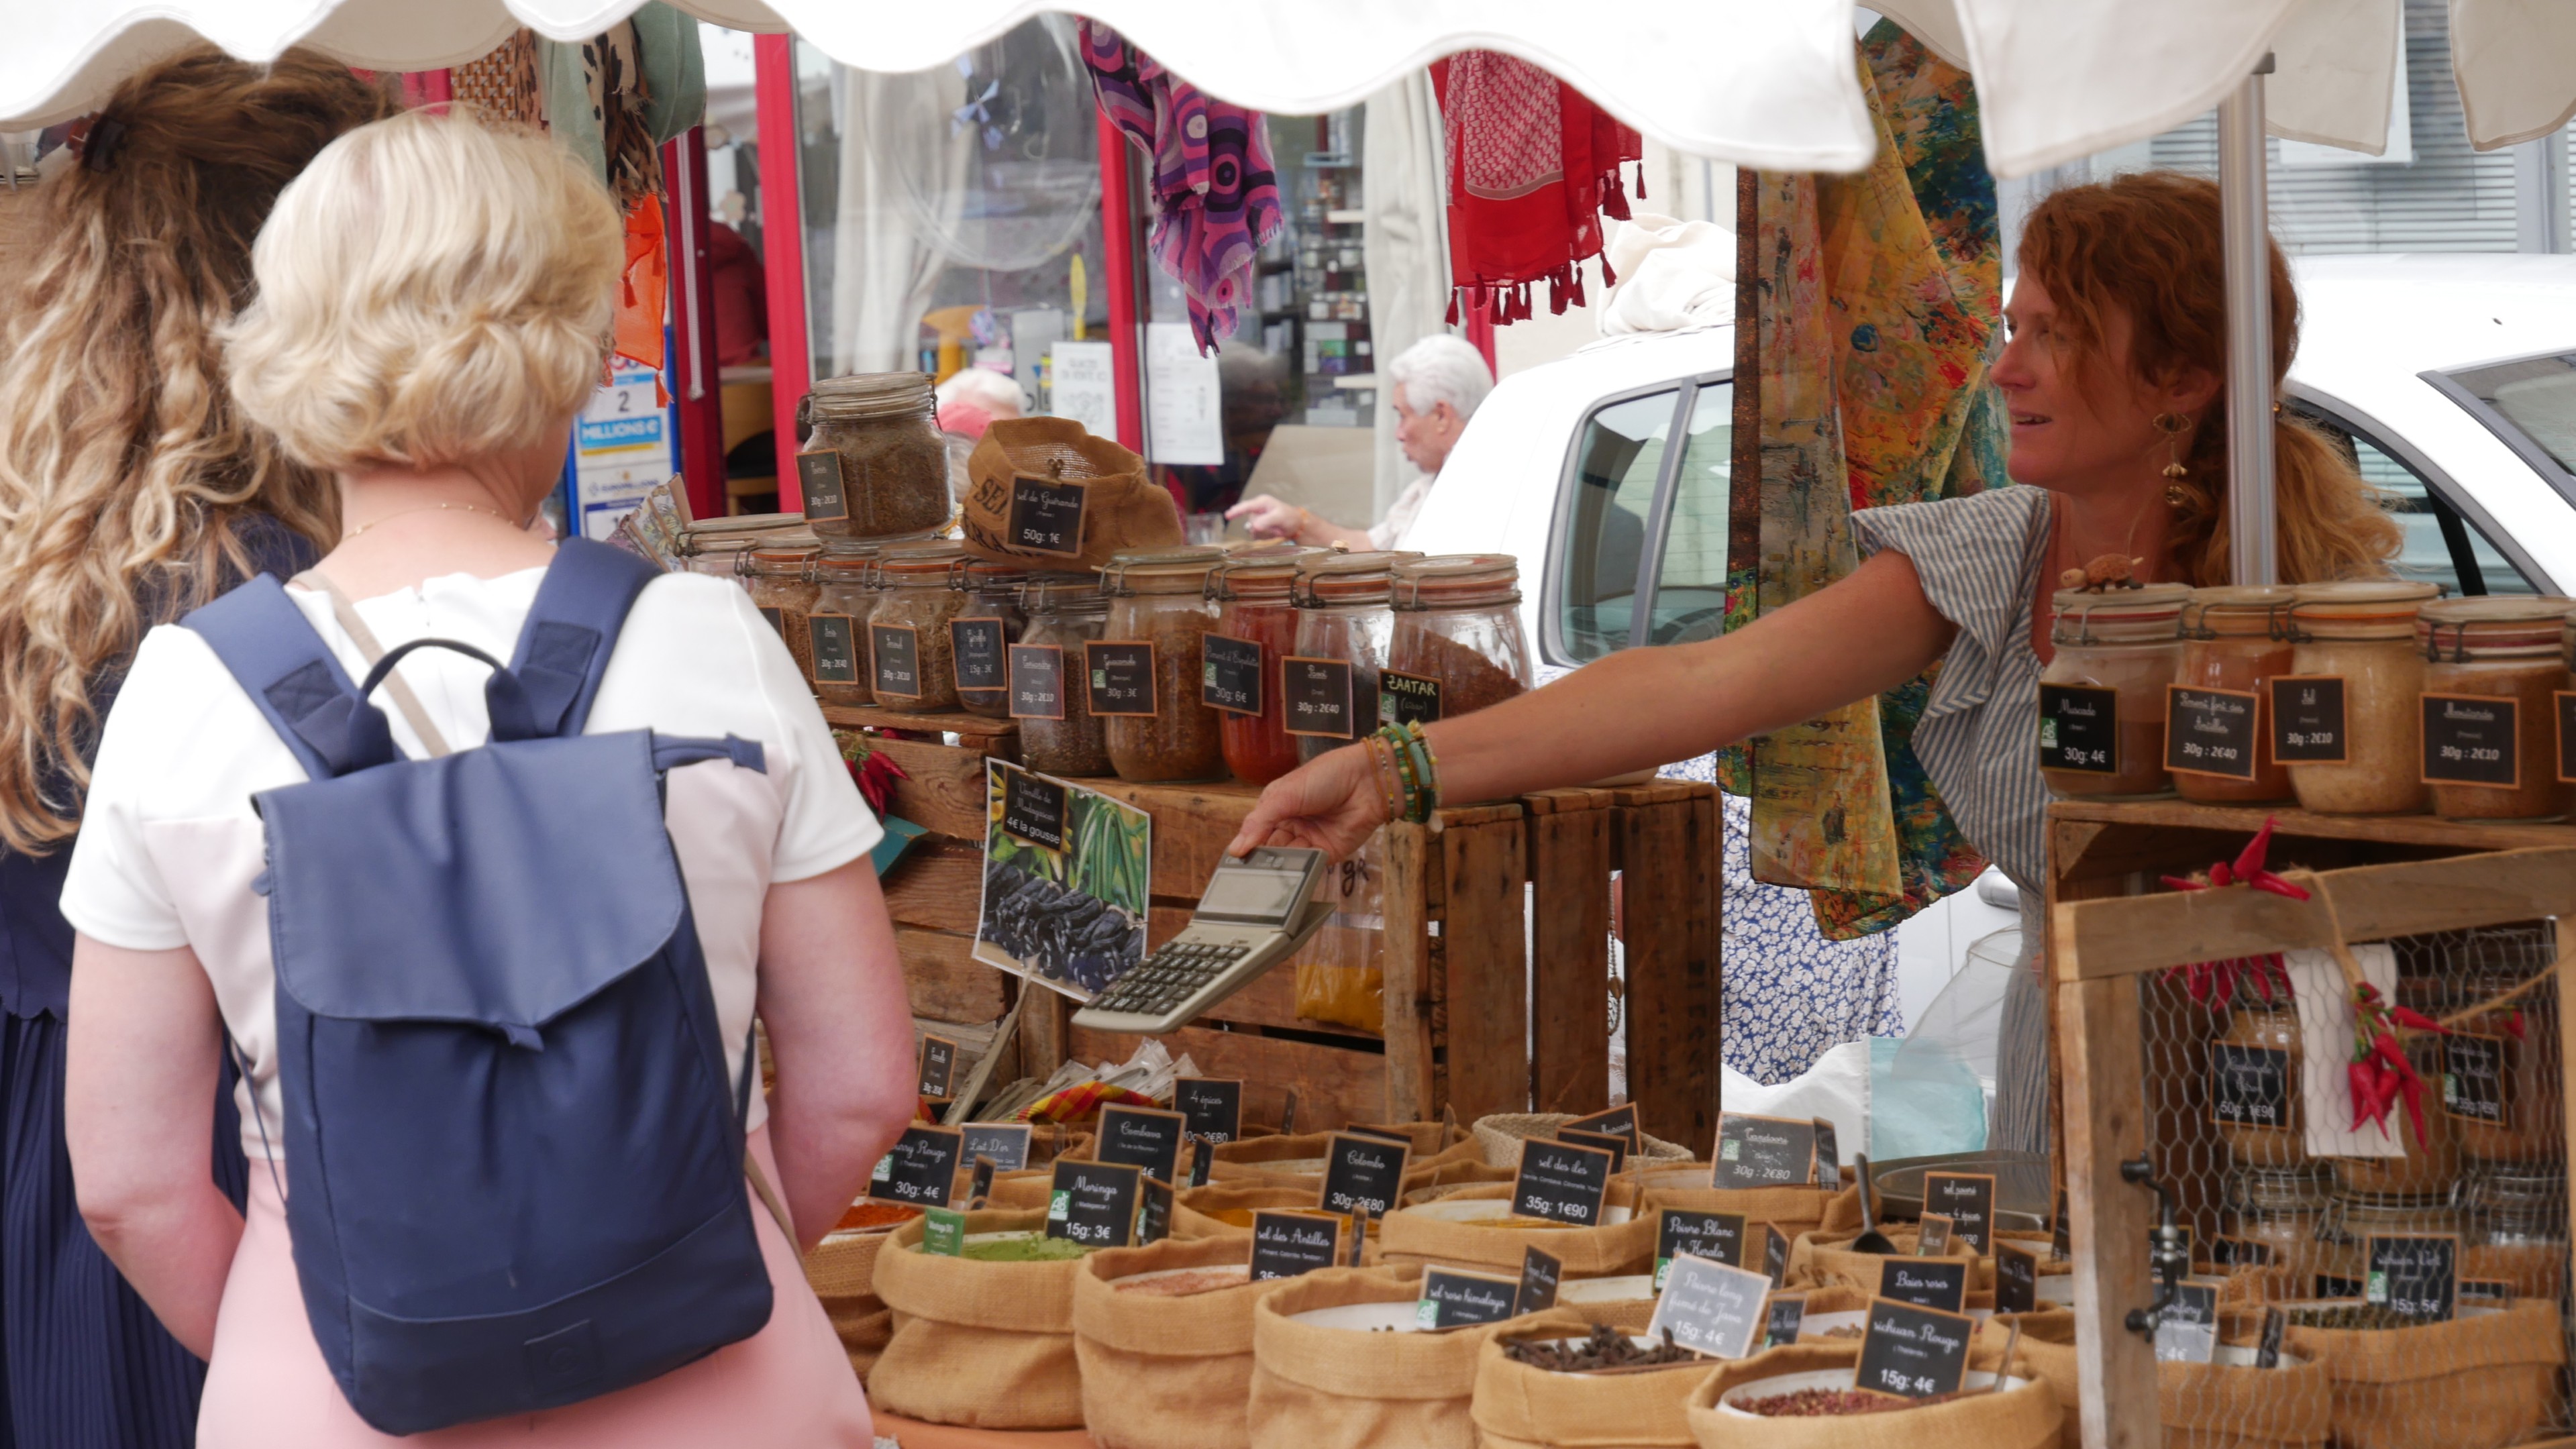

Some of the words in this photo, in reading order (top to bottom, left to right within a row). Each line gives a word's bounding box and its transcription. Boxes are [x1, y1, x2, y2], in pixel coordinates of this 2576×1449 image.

[618, 391, 629, 413] 2
[582, 421, 646, 439] MILLIONS
[1023, 529, 1045, 543] 50g:
[1049, 532, 1062, 544] 1€
[1215, 686, 1234, 702] 30g:
[1235, 690, 1247, 703] 6€
[1386, 674, 1437, 696] ZAATAR
[1319, 702, 1340, 714] 2€40
[2057, 698, 2097, 717] Muscade
[2310, 732, 2333, 745] 2€10
[2064, 747, 2088, 764] 30g:
[2090, 749, 2106, 763] 4€
[2210, 746, 2238, 760] 2€40
[2470, 747, 2500, 760] 2€10
[1007, 816, 1019, 829] 4€
[1019, 820, 1028, 833] la
[1029, 826, 1060, 844] gousse
[1190, 1090, 1199, 1104] 4
[1200, 1093, 1223, 1110] épices
[1120, 1121, 1162, 1139] Combava
[890, 1142, 915, 1159] urry
[917, 1140, 947, 1163] Rouge
[969, 1138, 988, 1151] Lait
[1347, 1150, 1386, 1169] Colombo
[1539, 1155, 1554, 1167] sel
[1553, 1157, 1569, 1171] des
[1762, 1168, 1790, 1179] 2€80
[895, 1181, 921, 1197] 30g:
[923, 1185, 940, 1199] 4€
[1071, 1175, 1118, 1201] Moringa
[1331, 1192, 1355, 1210] 30g:
[1357, 1197, 1385, 1212] 2€80
[1526, 1195, 1553, 1214] 35g:
[1557, 1201, 1588, 1219] 1€90
[1066, 1222, 1092, 1240] 15g:
[1094, 1224, 1111, 1239] 3€
[1669, 1216, 1700, 1234] Poivre
[1702, 1218, 1735, 1237] Blanc
[1257, 1226, 1272, 1240] sel
[1272, 1228, 1288, 1242] des
[1290, 1228, 1331, 1247] Antilles
[1690, 1240, 1724, 1258] Kerala
[1684, 1271, 1716, 1295] Poivre
[1718, 1282, 1743, 1308] long
[1896, 1271, 1923, 1289] Baies
[1924, 1279, 1949, 1289] roses
[1430, 1283, 1443, 1299] sel
[1444, 1287, 1463, 1301] rose
[1463, 1288, 1506, 1313] himalaya
[2391, 1299, 2418, 1314] 15g:
[2420, 1299, 2440, 1313] 5€
[1698, 1299, 1712, 1315] de
[1712, 1303, 1743, 1326] Java
[1676, 1320, 1703, 1342] 15g:
[1705, 1329, 1725, 1346] 4€
[1873, 1318, 1917, 1340] sichuan
[1921, 1324, 1961, 1354] Rouge
[1880, 1368, 1911, 1391] 15g:
[1914, 1375, 1936, 1394] 4€
